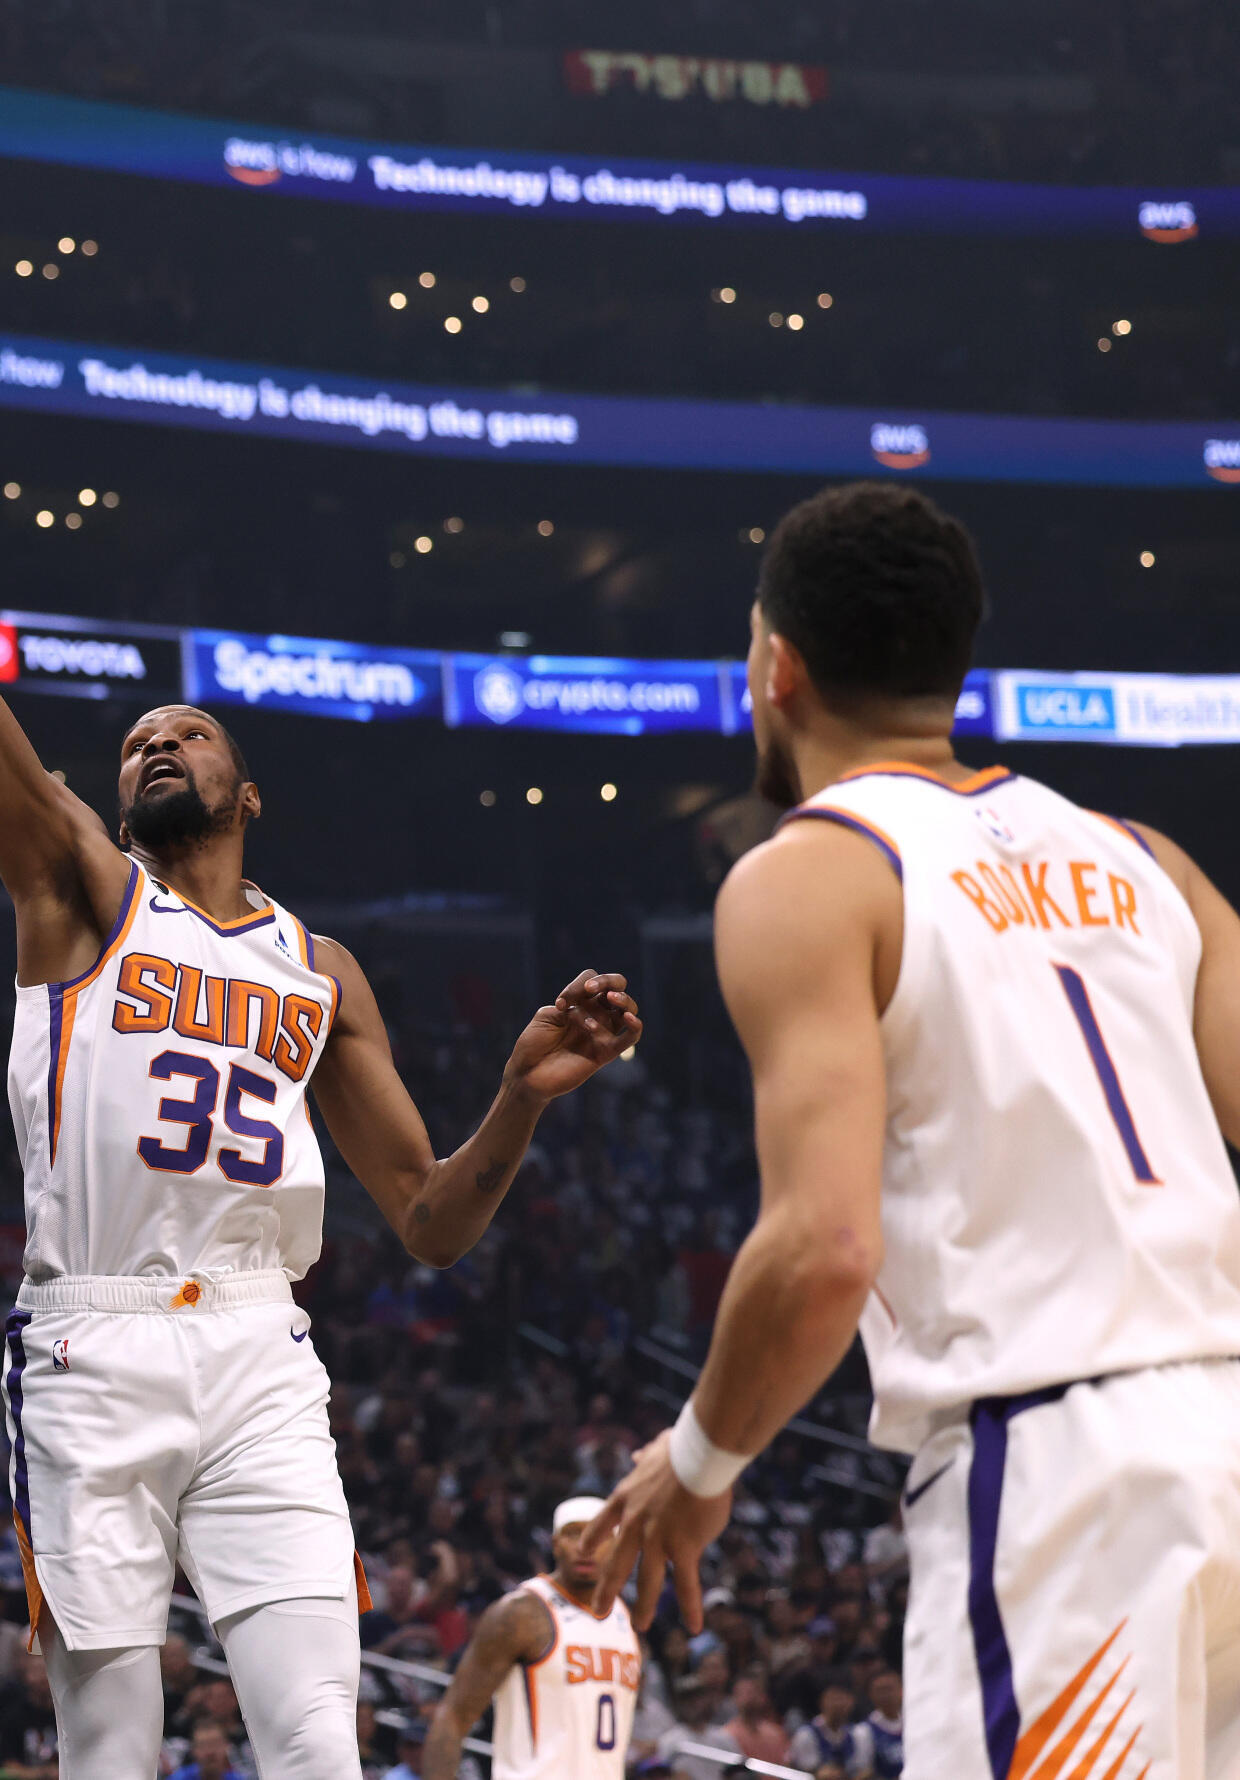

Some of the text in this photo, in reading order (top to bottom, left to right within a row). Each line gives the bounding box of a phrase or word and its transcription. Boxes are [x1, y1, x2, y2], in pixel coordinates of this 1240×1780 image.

[225, 137, 866, 221] aws is how Technology is changing the game
[1138, 201, 1196, 229] aws
[1, 349, 62, 388] how
[78, 358, 257, 420] Technology
[258, 378, 290, 417] is
[292, 384, 427, 441] changing
[429, 400, 485, 439] the
[486, 410, 578, 447] game
[870, 423, 928, 454] aws
[1203, 439, 1240, 468] aw
[18, 636, 146, 679] TOYOTA
[213, 640, 415, 705] Spectrum
[523, 677, 699, 714] crypto.com
[1025, 690, 1109, 726] UCLA
[111, 952, 324, 1083] SUNS
[1050, 960, 1164, 1187] 1
[137, 1050, 284, 1188] 35
[597, 1693, 616, 1751] 0
